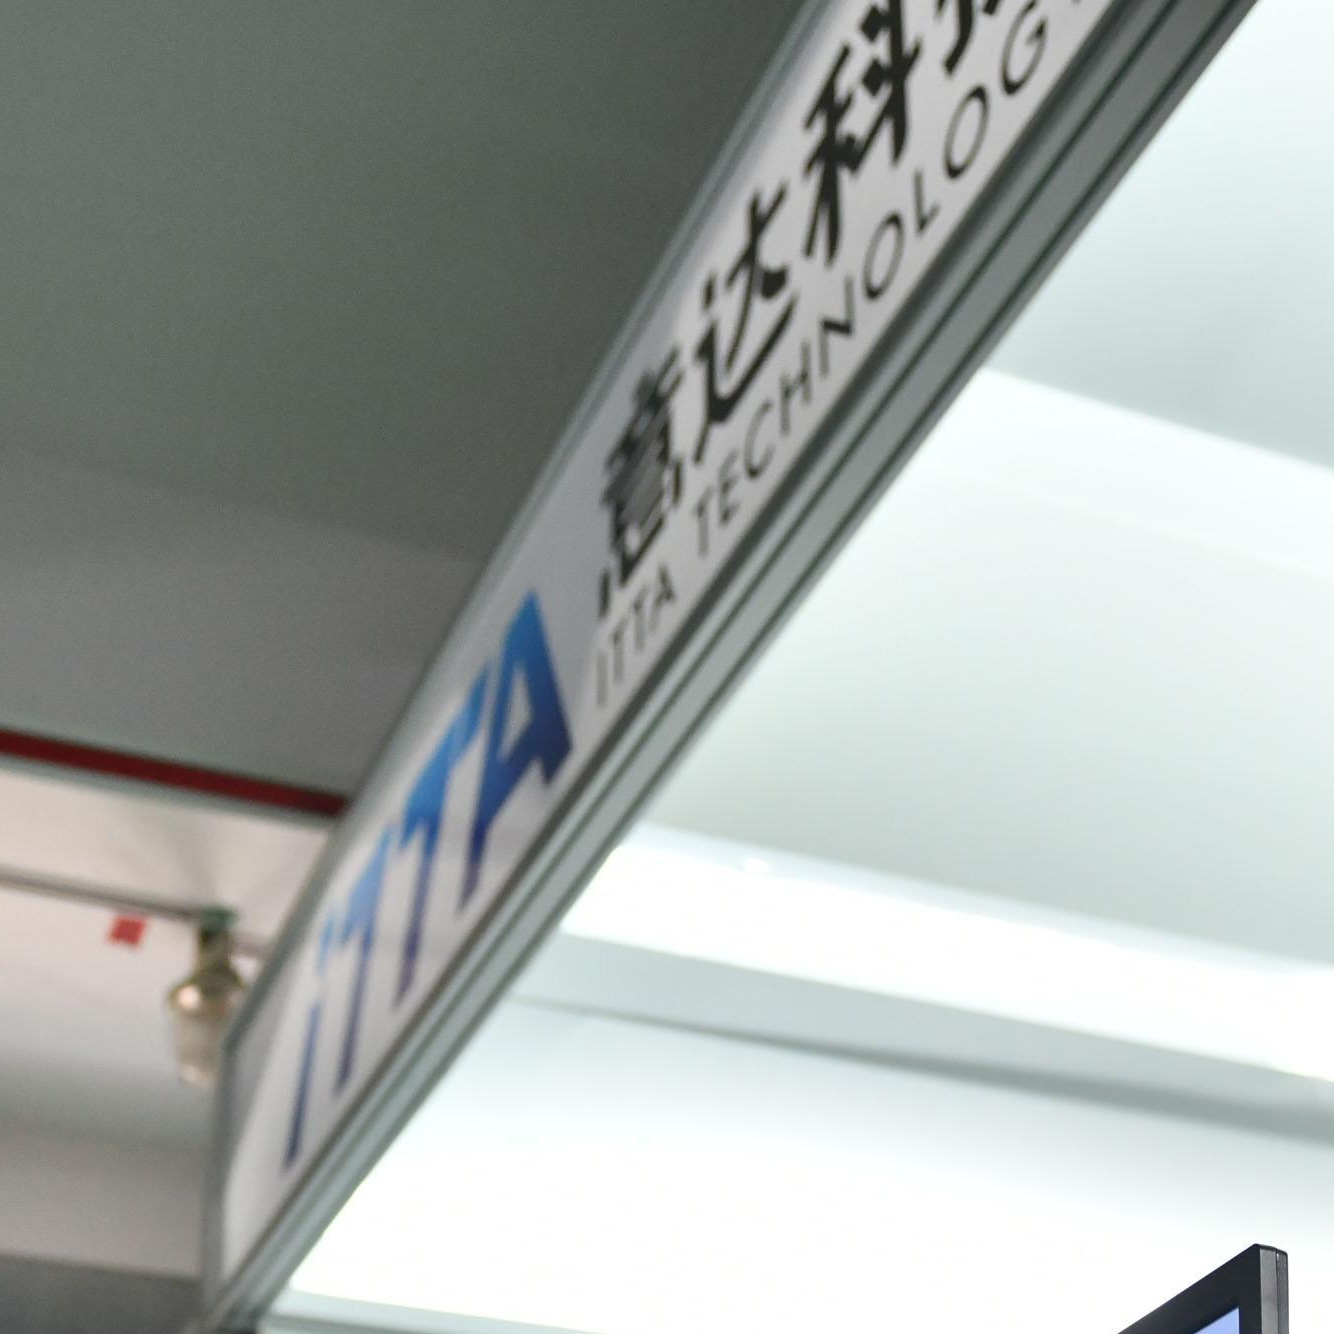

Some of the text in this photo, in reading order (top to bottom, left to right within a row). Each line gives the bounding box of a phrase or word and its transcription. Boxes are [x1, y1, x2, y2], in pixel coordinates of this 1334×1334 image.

[595, 0, 1005, 618] 意达科
[596, 0, 1079, 709] ITTA TECHNOLOG
